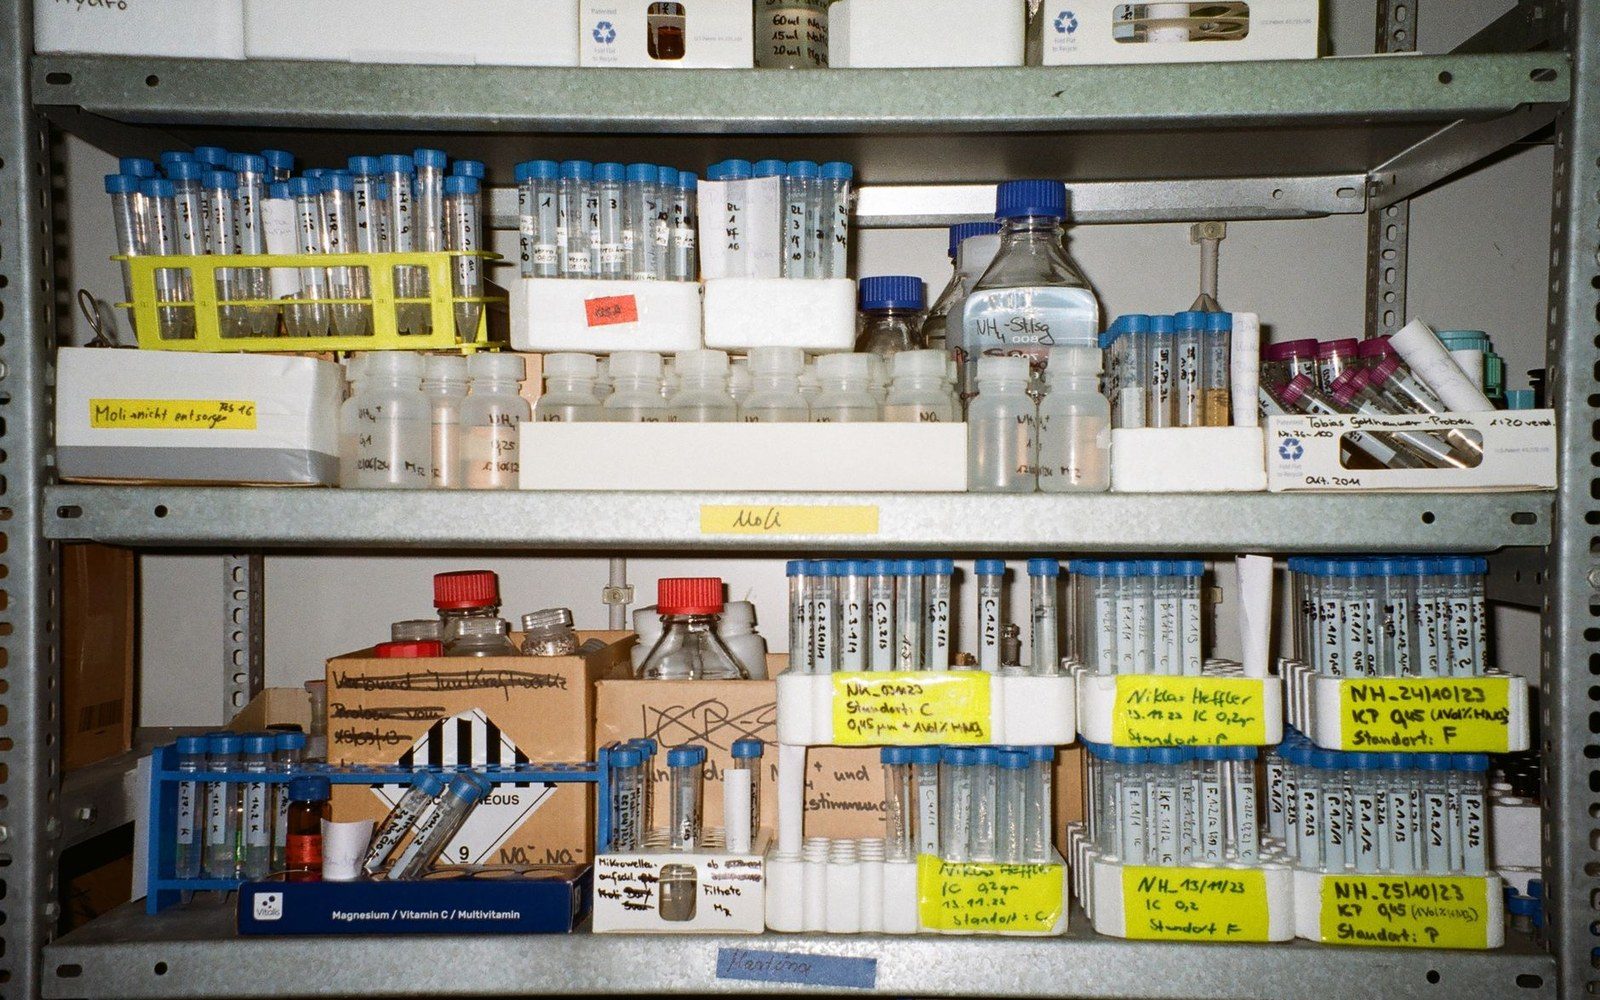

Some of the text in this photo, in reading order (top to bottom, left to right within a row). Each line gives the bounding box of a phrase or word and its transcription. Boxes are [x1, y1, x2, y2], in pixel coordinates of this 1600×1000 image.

[1306, 416, 1345, 428] Tobias
[919, 702, 933, 716] C
[1352, 726, 1457, 747] Standort: F
[834, 765, 870, 781] und
[459, 846, 470, 860] 9
[332, 909, 520, 921] Magnesium / Vitamin C / Multivitamin
[1424, 926, 1440, 943] P
